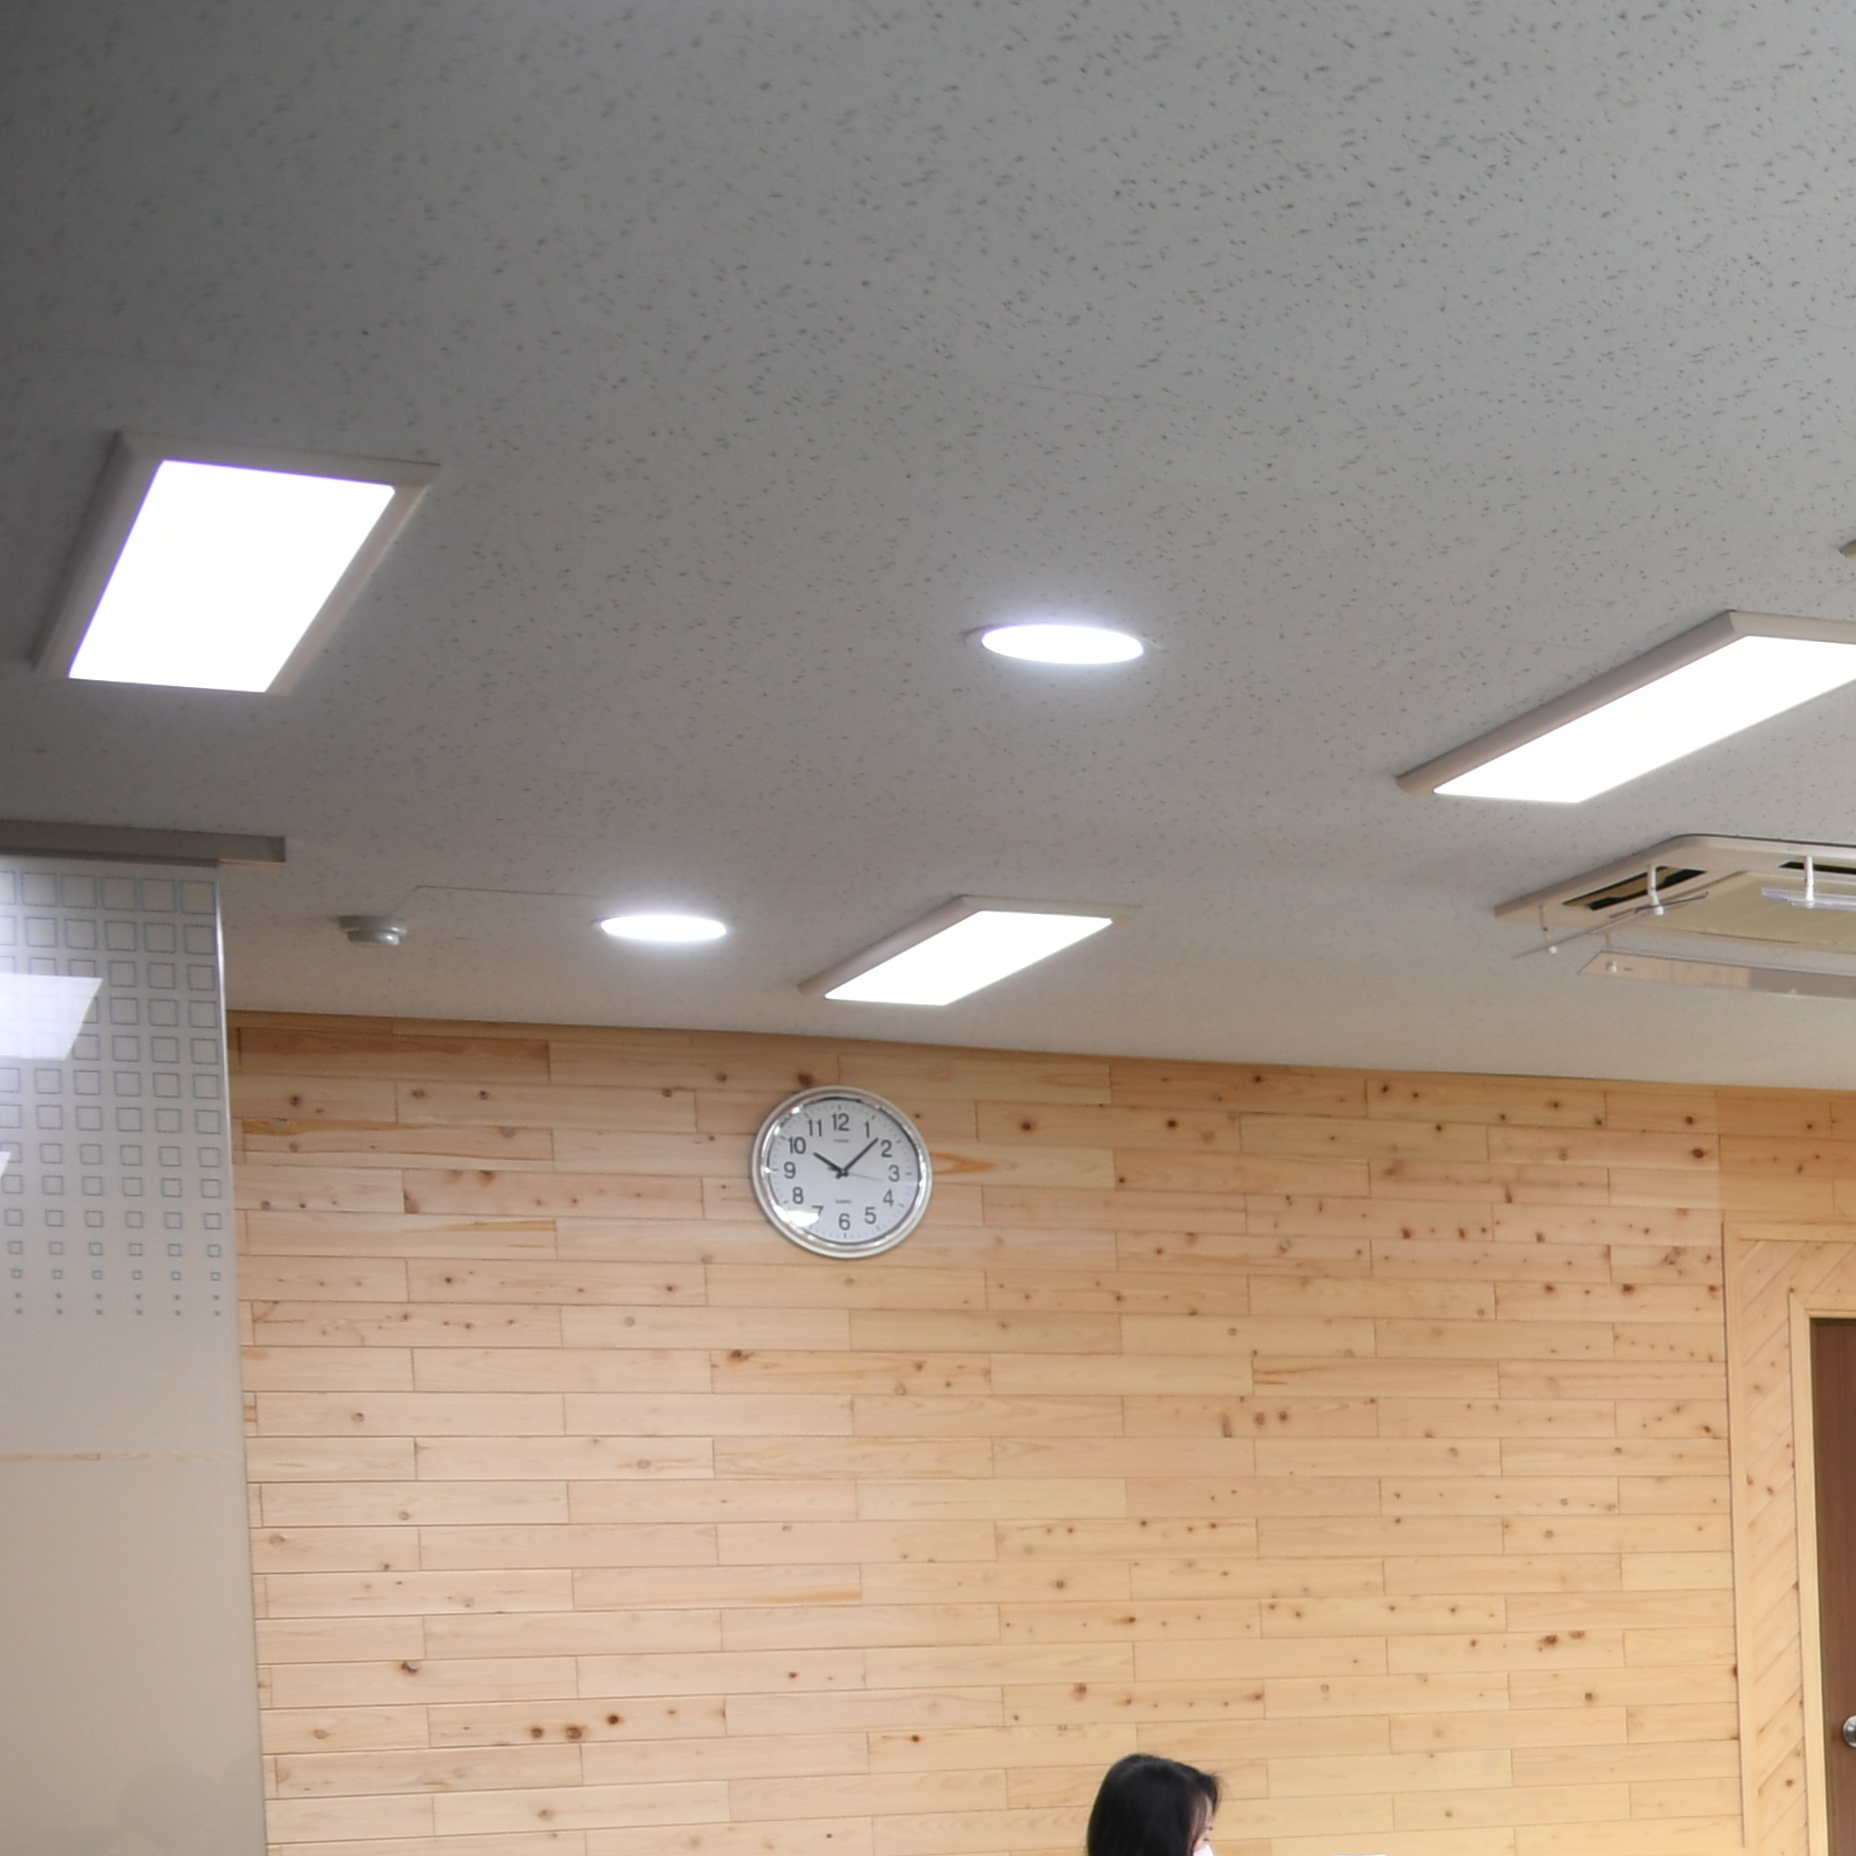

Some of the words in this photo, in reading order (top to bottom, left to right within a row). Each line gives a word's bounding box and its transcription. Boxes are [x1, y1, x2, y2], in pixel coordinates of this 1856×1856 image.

[808, 1119, 823, 1137] 11
[831, 1113, 850, 1132] 12
[864, 1121, 870, 1138] 1
[788, 1136, 806, 1155] 10
[880, 1139, 892, 1158] 2
[783, 1161, 796, 1179] 9
[888, 1164, 900, 1183] 3
[792, 1186, 804, 1205] 8
[883, 1189, 894, 1208] 4
[838, 1213, 851, 1231] 6
[864, 1206, 877, 1224] 5
